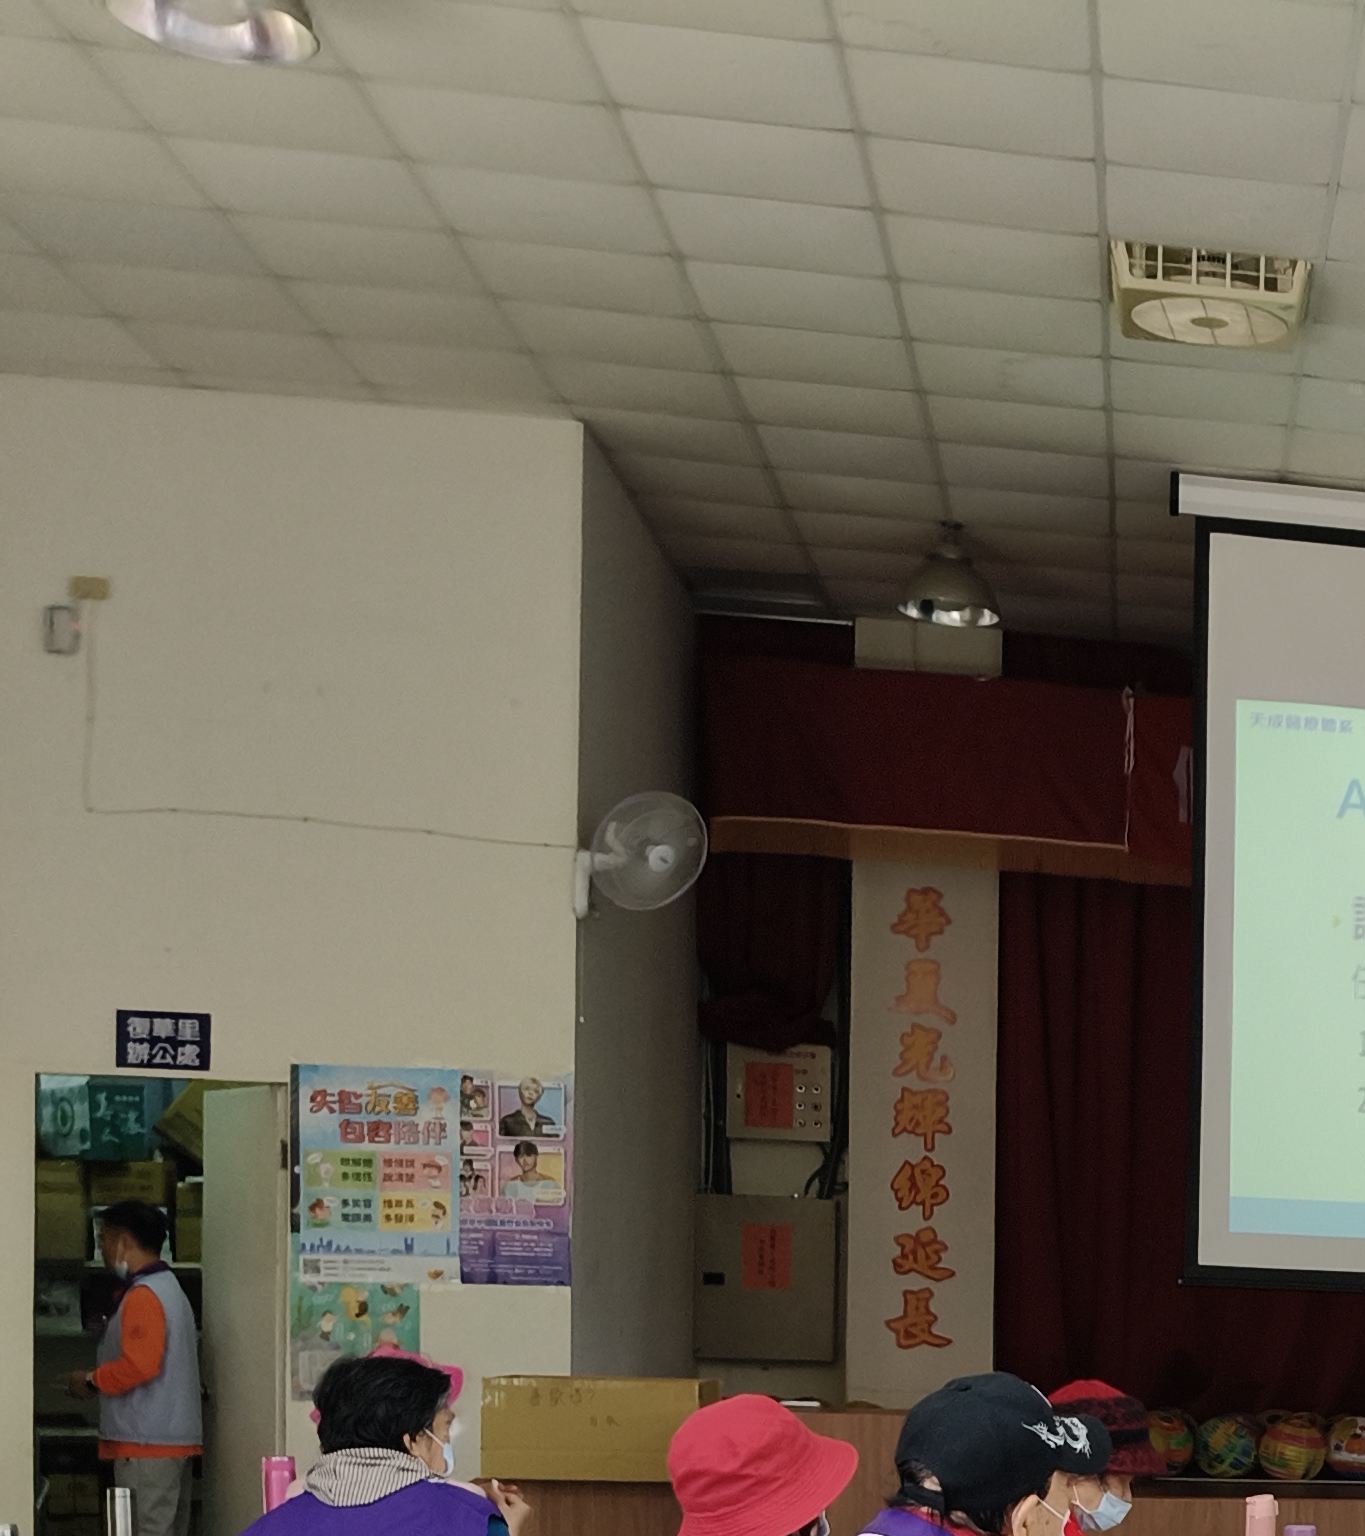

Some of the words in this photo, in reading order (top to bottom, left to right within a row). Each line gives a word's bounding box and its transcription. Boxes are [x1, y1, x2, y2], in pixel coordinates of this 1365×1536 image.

[309, 1086, 420, 1117] 失智友善
[338, 1118, 448, 1146] 包容陪伴
